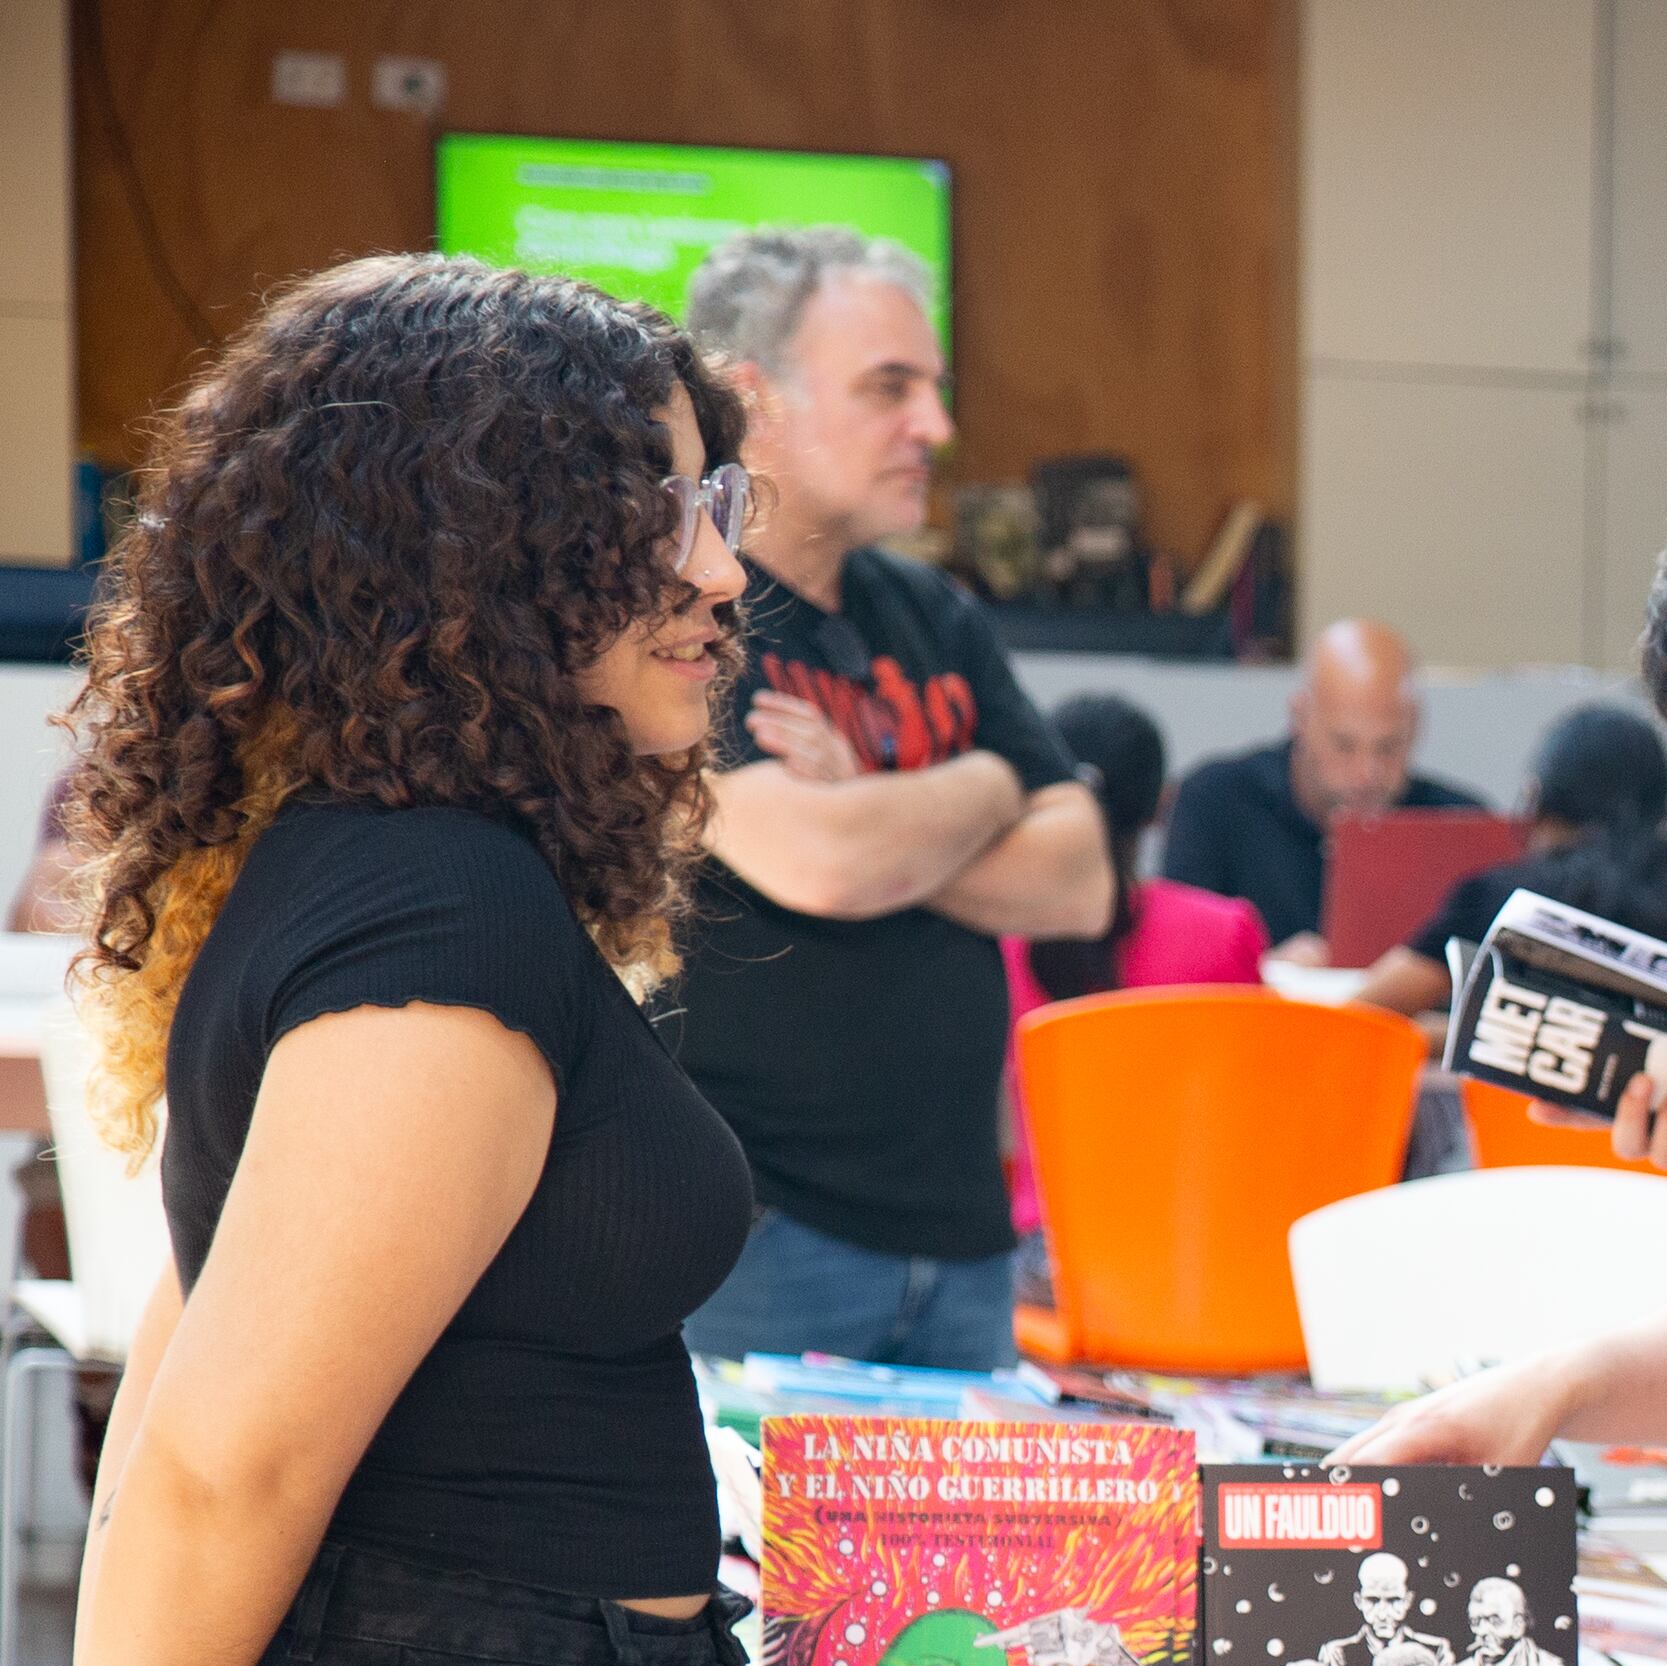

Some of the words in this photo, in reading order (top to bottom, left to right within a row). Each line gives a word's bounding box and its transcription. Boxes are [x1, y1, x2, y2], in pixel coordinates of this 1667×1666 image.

[1469, 977, 1549, 1076] MET
[1526, 997, 1608, 1094] CAR
[803, 1432, 842, 1462] LA
[852, 1428, 936, 1463] NIÑA
[942, 1435, 1135, 1466] COMUNISTA
[776, 1474, 798, 1498] Y
[805, 1474, 846, 1502] EL
[851, 1468, 932, 1502] NIÑO
[937, 1475, 1159, 1504] GUERRILLERO
[876, 1509, 987, 1527] HISTORIETA
[1224, 1495, 1262, 1540] UN
[1264, 1495, 1376, 1540] FAULDUO
[879, 1532, 927, 1548] 100%
[933, 1533, 1056, 1550] TESTIMONIAL
